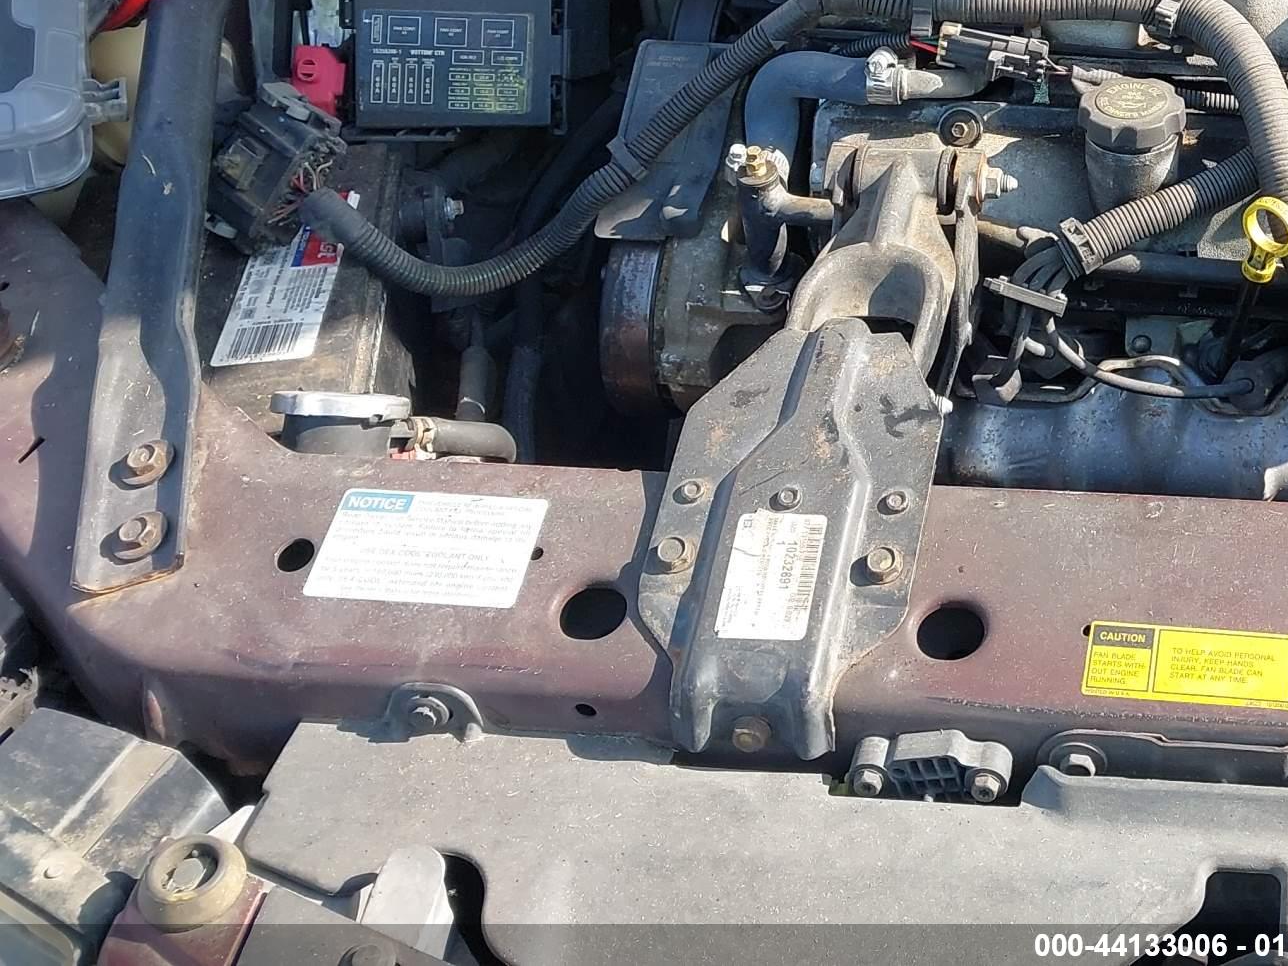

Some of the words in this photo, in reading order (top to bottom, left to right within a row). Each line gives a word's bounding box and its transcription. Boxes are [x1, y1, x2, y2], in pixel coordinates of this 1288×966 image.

[1106, 82, 1149, 95] ENGINE
[348, 495, 407, 511] NOTICE
[1099, 630, 1146, 643] CAUTION
[1185, 648, 1206, 657] HELP
[1208, 650, 1233, 658] AVOID
[1092, 659, 1121, 668] STARTS
[1109, 668, 1139, 678] ENGINE
[1169, 672, 1196, 681] START
[1211, 674, 1228, 682] ANY
[1246, 668, 1263, 677] CAN
